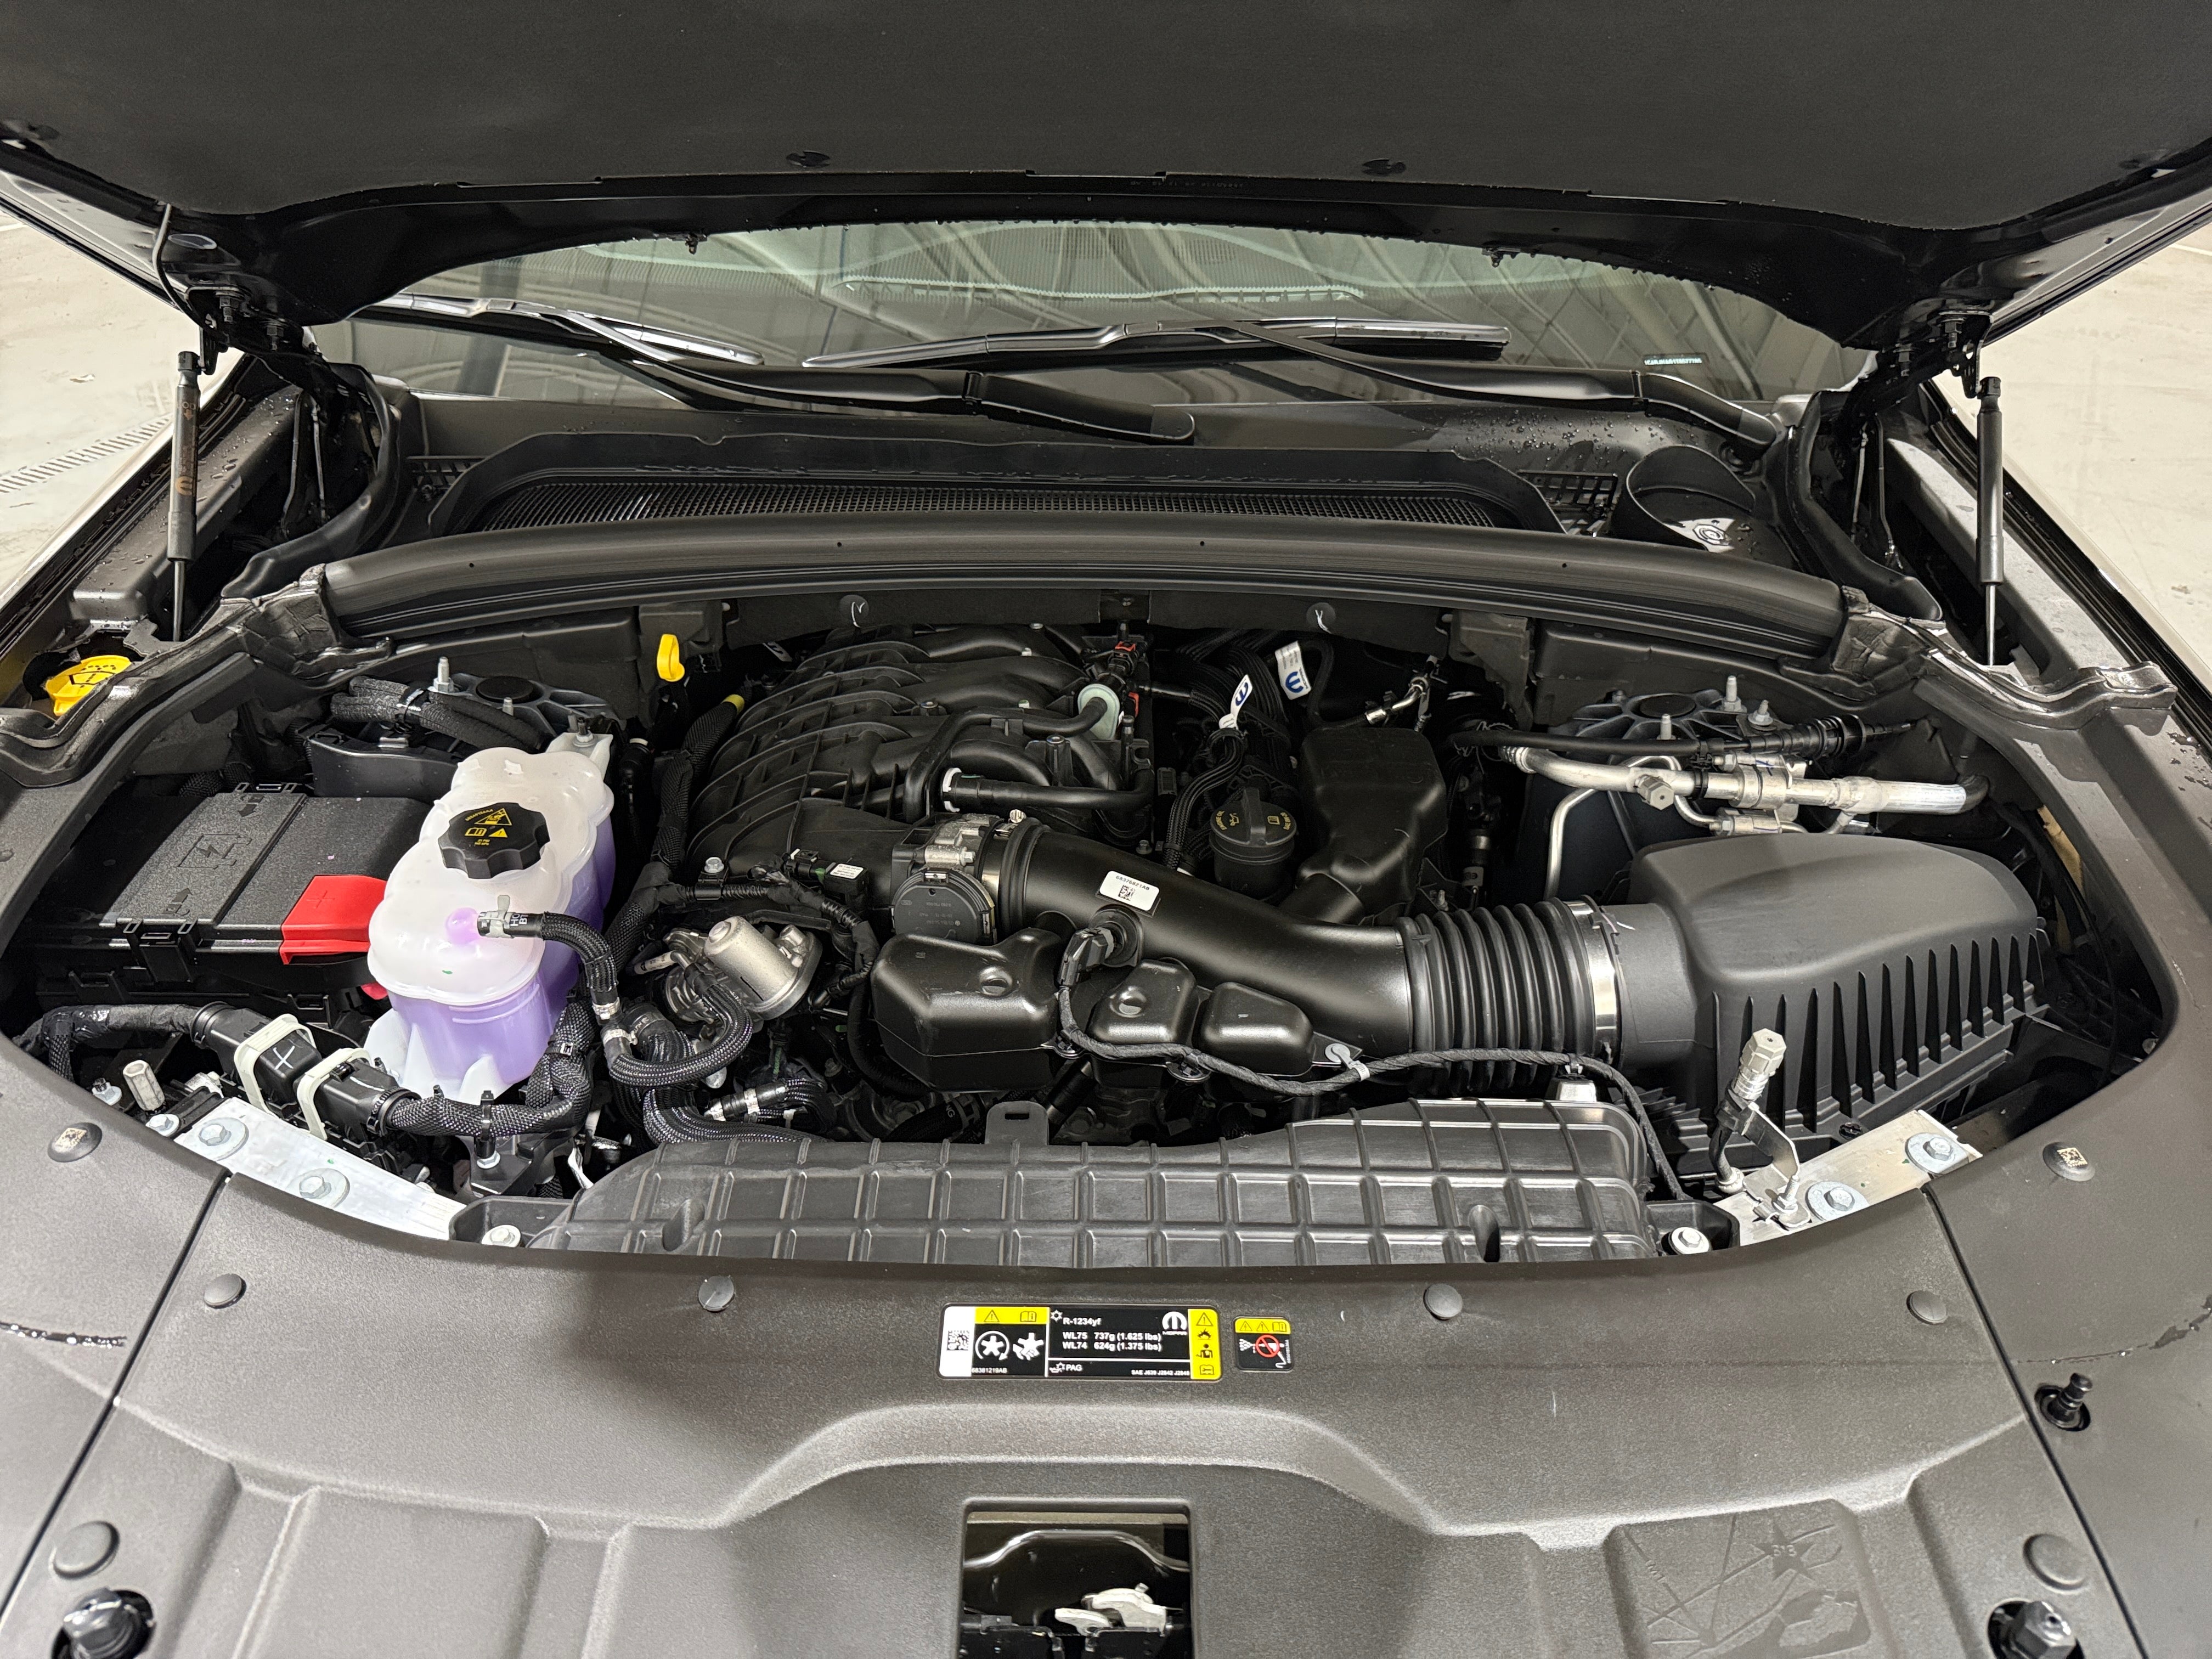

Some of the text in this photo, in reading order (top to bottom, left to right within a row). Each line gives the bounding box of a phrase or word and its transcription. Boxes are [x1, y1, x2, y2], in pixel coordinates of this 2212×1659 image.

[1063, 1317, 1102, 1327] R-1234yf
[1062, 1331, 1162, 1342] WL75 737g (1.625 lbs)
[1062, 1341, 1162, 1352] WL74 624g (1.375 lbs)
